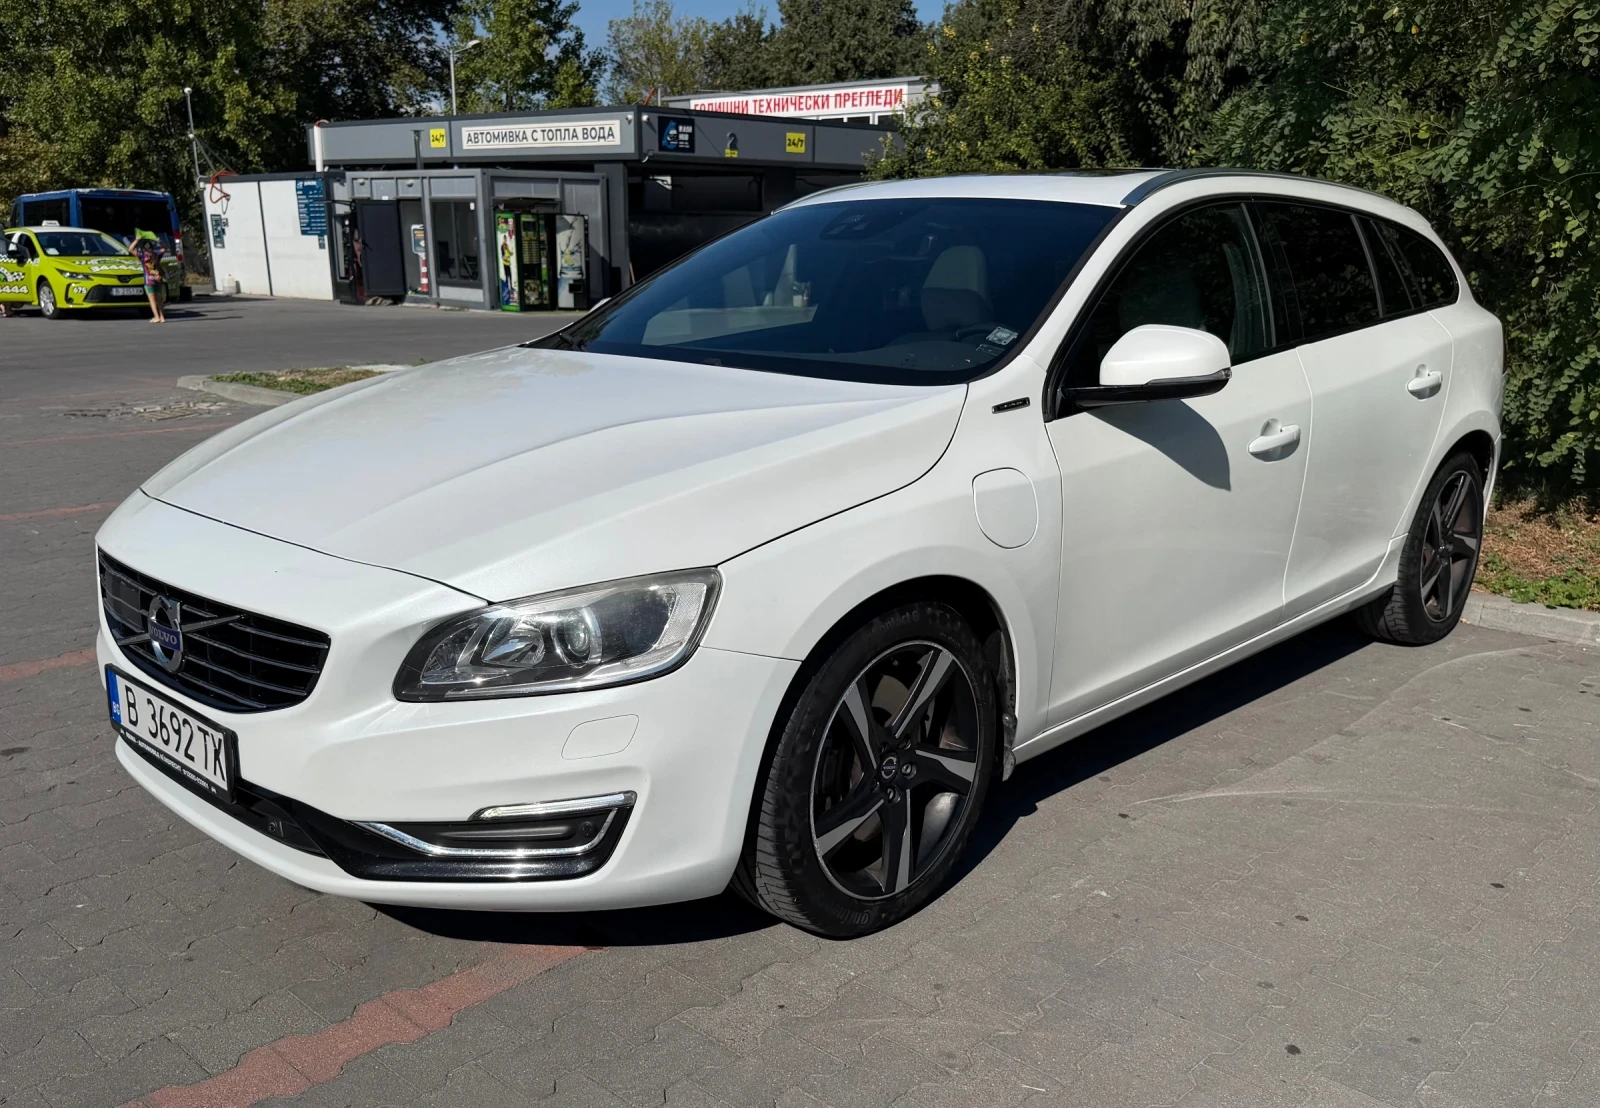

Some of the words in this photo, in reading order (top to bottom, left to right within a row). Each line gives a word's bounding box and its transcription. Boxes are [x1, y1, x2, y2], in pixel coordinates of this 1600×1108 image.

[753, 94, 830, 114] ТЕХНИЧЕСКИ
[834, 88, 903, 109] ПРЕГЛЕДИ
[431, 133, 445, 143] 24/7
[466, 130, 528, 145] АВТОМИВКА
[531, 129, 539, 141] С
[540, 127, 579, 142] ТОПЛА
[582, 126, 615, 142] ВОДА
[787, 138, 804, 149] 24/7
[150, 624, 178, 645] VOLVO
[112, 701, 120, 715] BG
[125, 685, 138, 727] B
